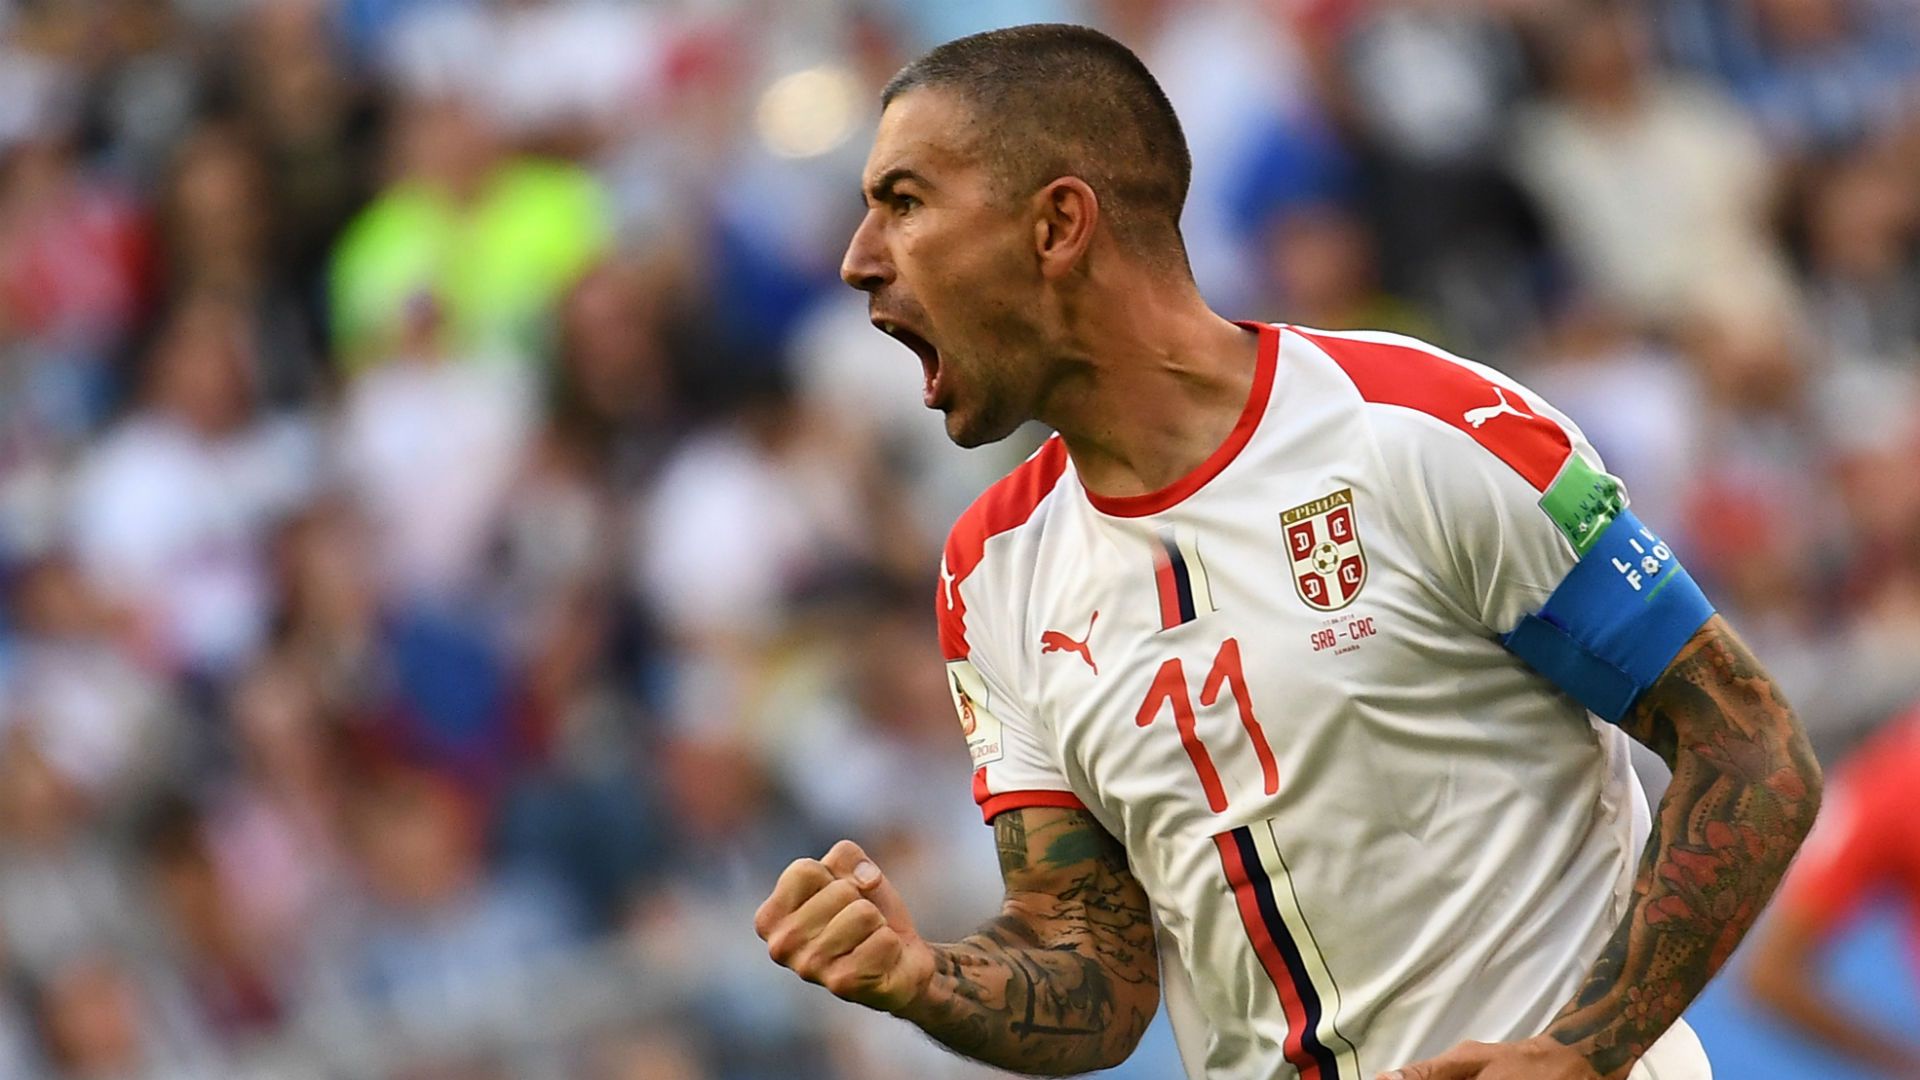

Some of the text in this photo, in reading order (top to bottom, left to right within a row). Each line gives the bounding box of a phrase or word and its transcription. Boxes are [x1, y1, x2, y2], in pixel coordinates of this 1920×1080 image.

[1282, 492, 1348, 523] СРБИЈА
[1310, 628, 1337, 652] SRB
[1348, 616, 1377, 640] CRC
[1135, 637, 1279, 813] 11
